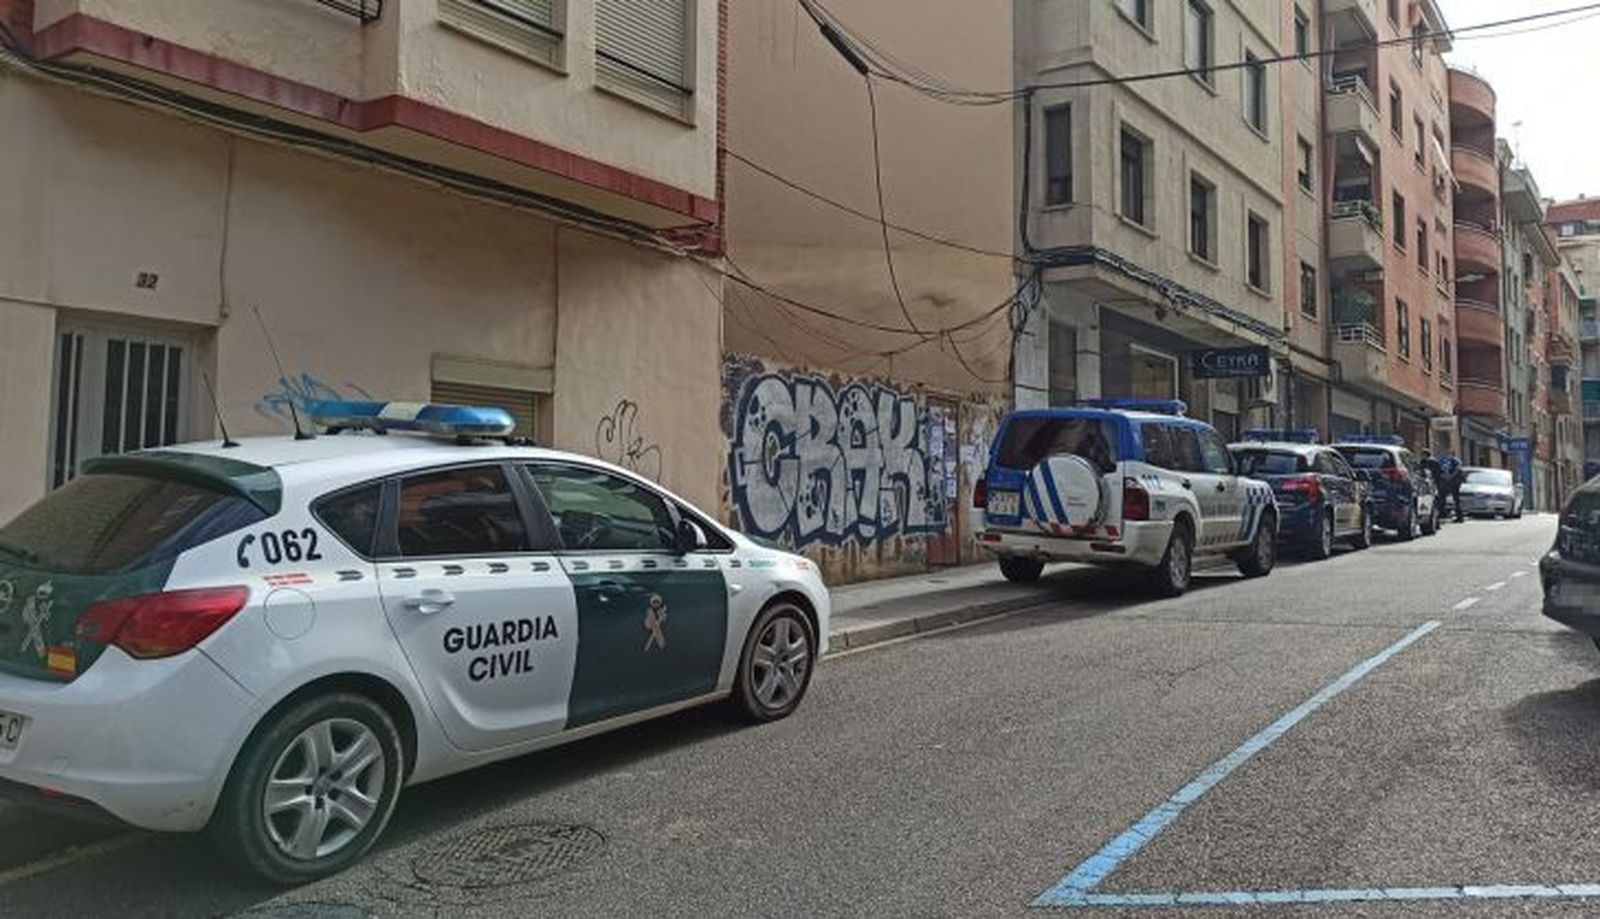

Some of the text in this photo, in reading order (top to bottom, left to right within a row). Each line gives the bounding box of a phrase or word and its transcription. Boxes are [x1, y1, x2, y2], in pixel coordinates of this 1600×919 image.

[261, 527, 322, 565] 062
[443, 615, 558, 654] GUARDIA
[468, 649, 534, 681] CIVIL
